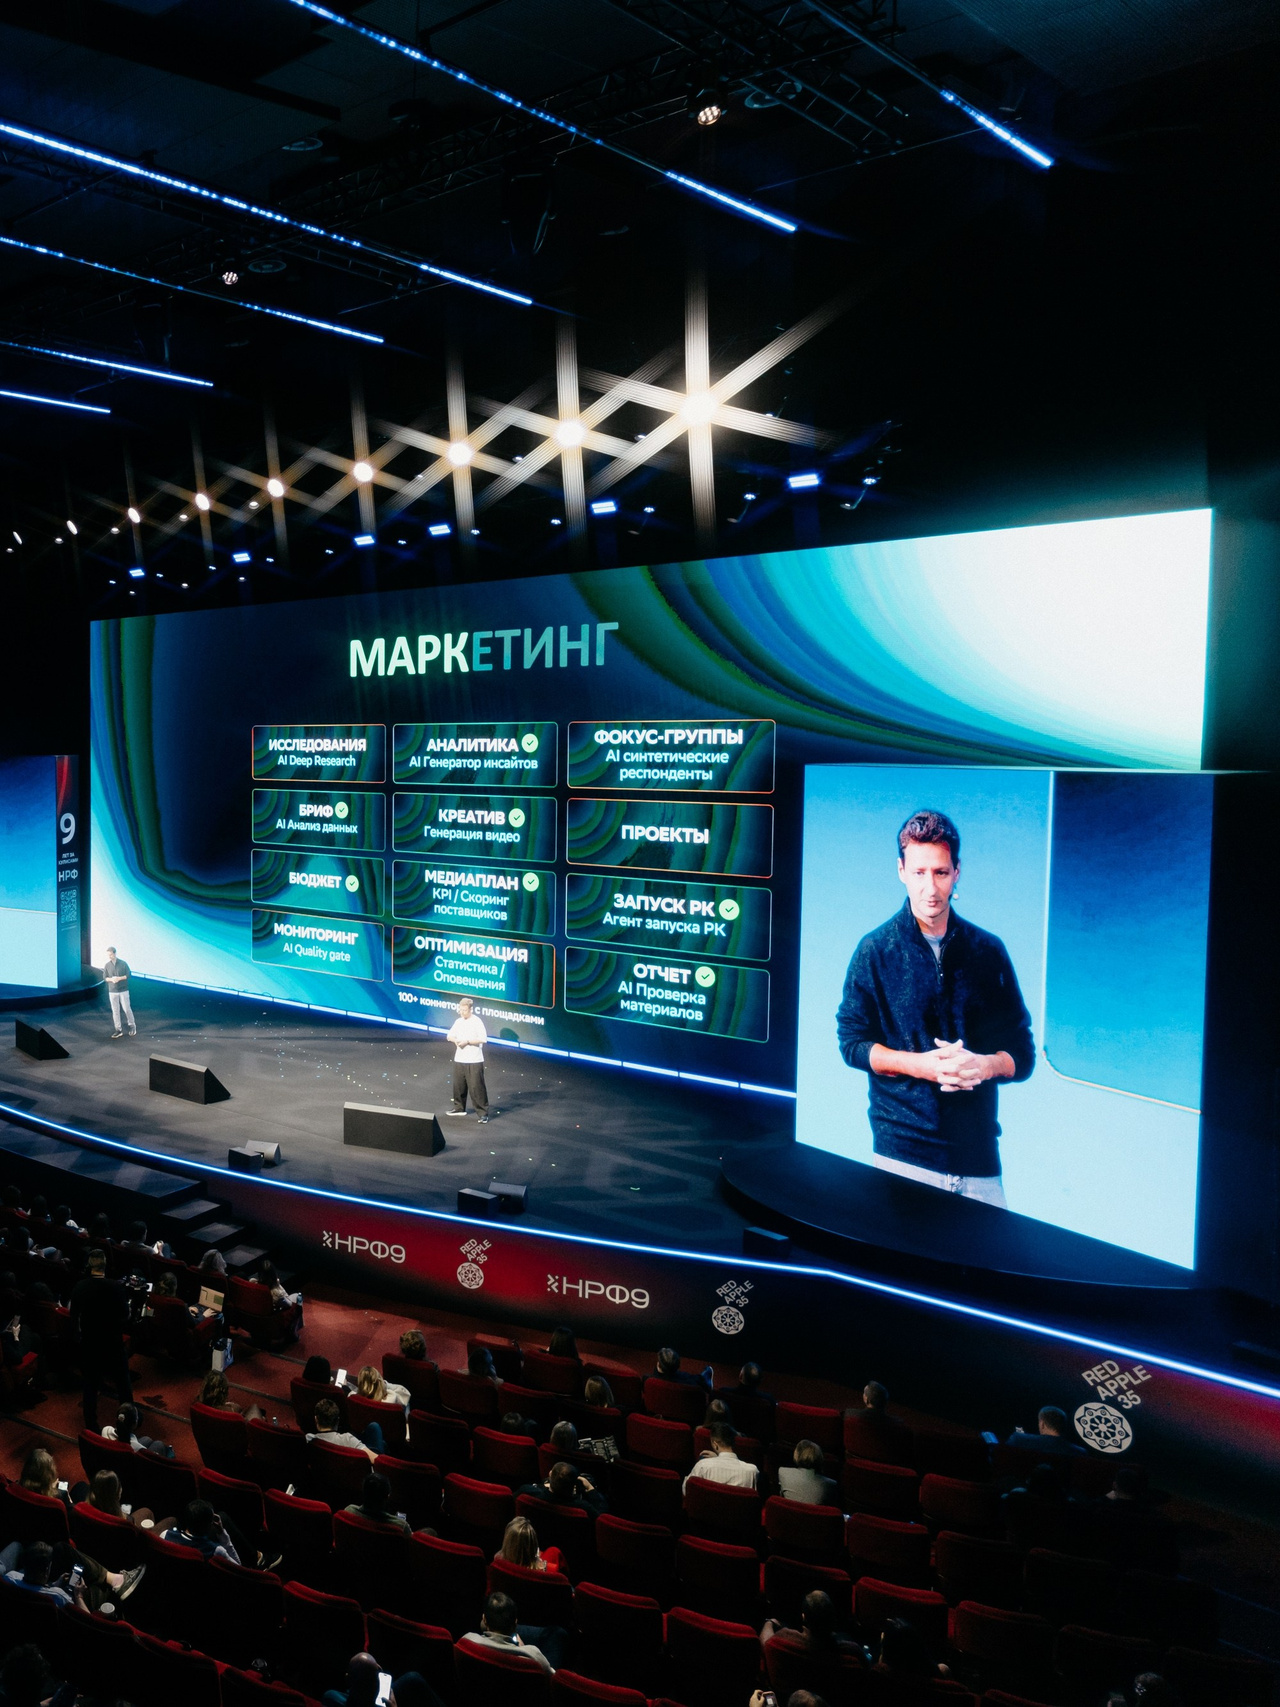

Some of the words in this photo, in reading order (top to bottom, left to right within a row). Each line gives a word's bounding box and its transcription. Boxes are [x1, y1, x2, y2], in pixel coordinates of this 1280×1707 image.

[350, 622, 619, 678] МАРКЕТИНГ
[268, 738, 367, 753] ИССЛЕДОВАНИЯ
[426, 738, 520, 753] АНАЛИТИКА
[593, 728, 744, 745] ФОКУС-ГРУППЫ
[277, 755, 288, 766] AI
[289, 755, 313, 768] Deep
[314, 755, 356, 767] Research
[409, 756, 421, 768] AI
[423, 756, 482, 771] Генератор
[484, 756, 539, 769] инсайтов
[605, 749, 620, 762] AI
[623, 750, 730, 764] синтетические
[619, 768, 713, 782] респонденты
[298, 803, 334, 818] БРИФ
[438, 808, 506, 825] КРЕАТИВ
[60, 812, 76, 845] 9
[276, 818, 286, 829] AI
[287, 819, 321, 831] Анализ
[322, 823, 358, 834] данных
[423, 826, 483, 841] Генерация
[485, 831, 521, 843] видео
[621, 824, 710, 844] ПРОЕКТЫ
[58, 868, 79, 883] НРФ
[289, 871, 342, 889] БЮДЖЕТ
[424, 869, 519, 891] МЕДИАПЛАН
[432, 887, 452, 901] KPI
[453, 889, 460, 904] /
[460, 890, 510, 907] Скоринг
[613, 893, 687, 915] ЗАПУСК
[689, 900, 716, 918] РК
[434, 904, 508, 921] поставщиков
[273, 922, 359, 946] МОНИТОРИНГ
[602, 911, 643, 928] Агент
[645, 918, 701, 935] запуска
[703, 921, 727, 937] РК
[282, 943, 293, 954] AI
[294, 943, 328, 962] Quality
[329, 951, 351, 962] gate
[414, 936, 529, 963] ОПТИМИЗАЦИЯ
[434, 956, 498, 976] Статистика
[499, 963, 506, 979] /
[632, 962, 692, 985] ОТЧЕТ
[433, 970, 506, 992] Оповещения
[618, 981, 633, 995] AI
[635, 983, 707, 1006] Проверка
[397, 991, 419, 1004] 100+
[474, 1005, 481, 1014] с
[481, 1007, 545, 1026] площадками
[620, 999, 704, 1022] материалов
[335, 1232, 406, 1264] НРФ9
[459, 1238, 478, 1255] RED
[466, 1239, 492, 1262] APPLE
[476, 1253, 488, 1265] 35
[562, 1276, 650, 1309] НРФ9
[715, 1279, 737, 1298] RED
[724, 1280, 754, 1305] APPLE
[735, 1296, 749, 1308] 35
[1081, 1360, 1120, 1387] RED
[1096, 1364, 1152, 1401] APPLE
[1117, 1390, 1142, 1410] 35
